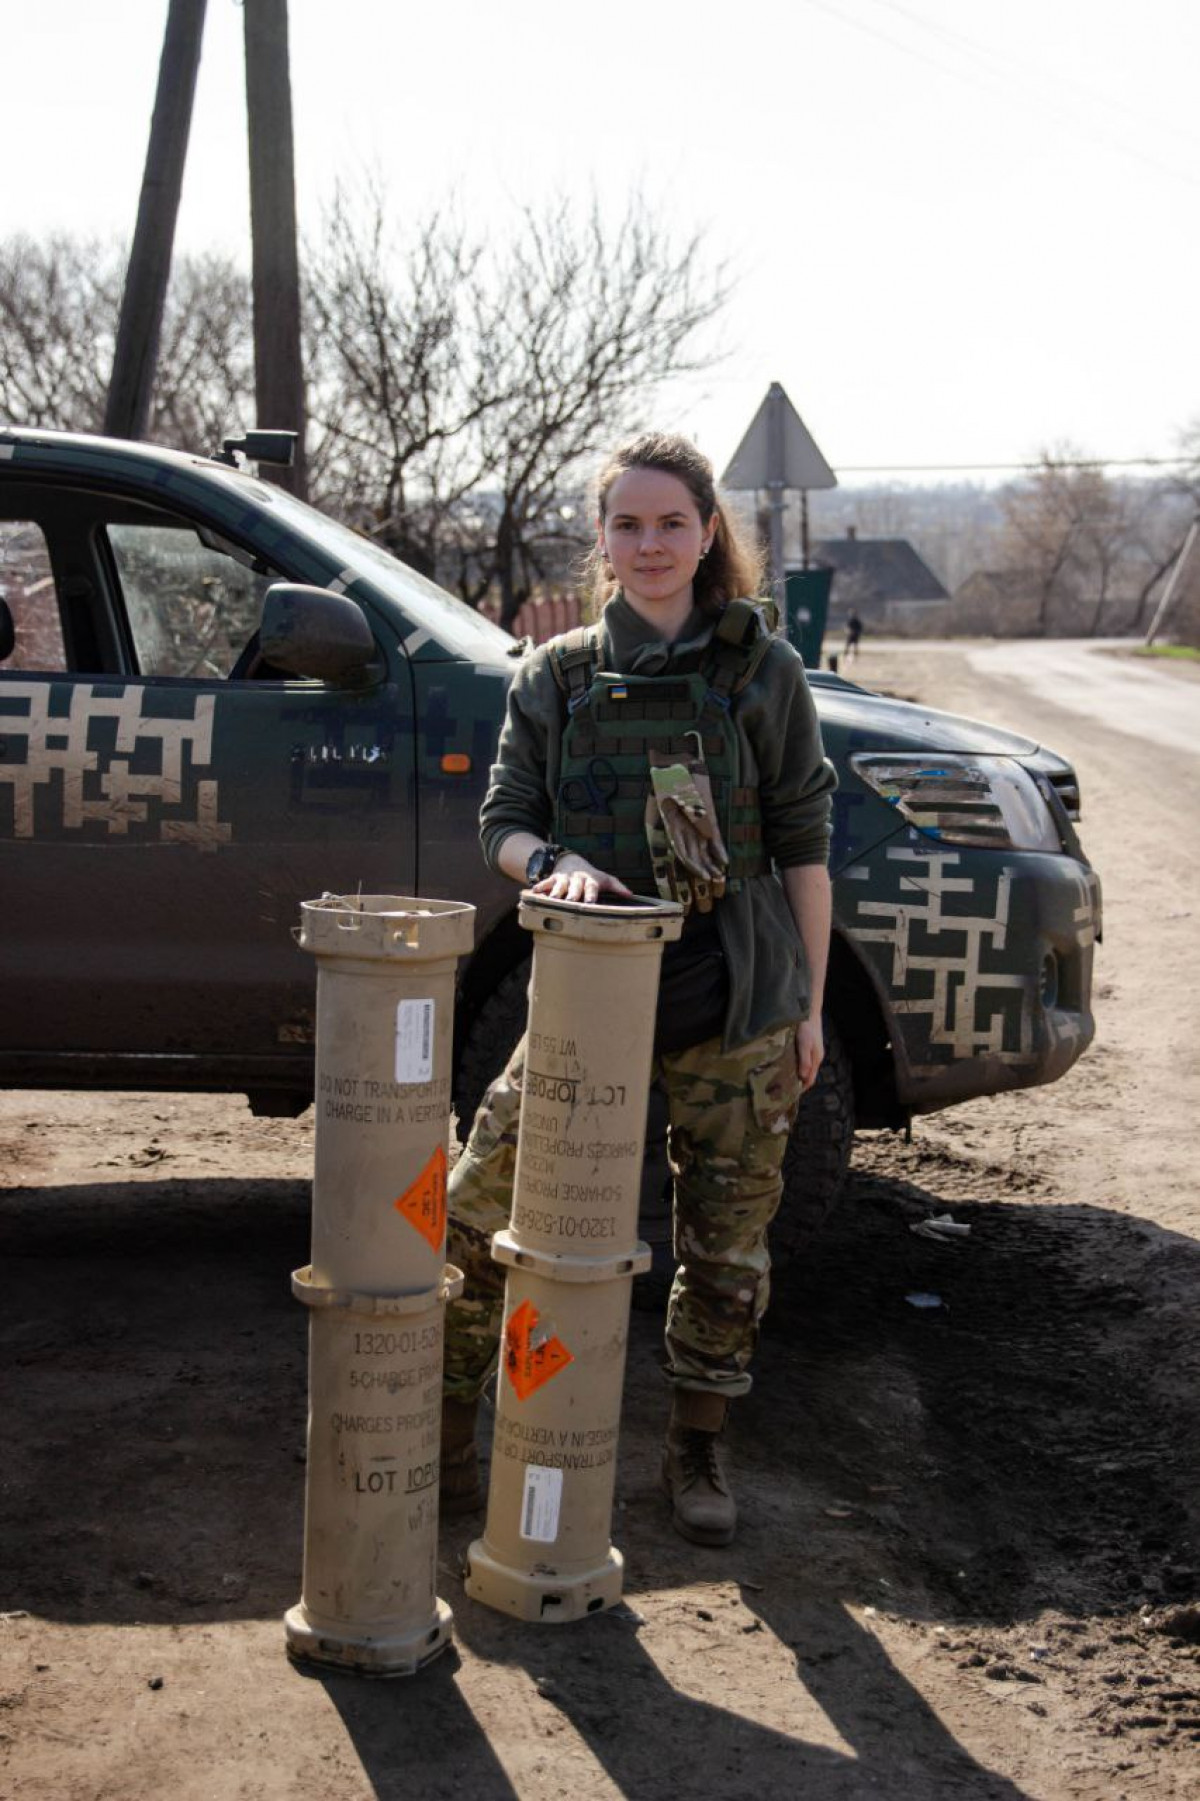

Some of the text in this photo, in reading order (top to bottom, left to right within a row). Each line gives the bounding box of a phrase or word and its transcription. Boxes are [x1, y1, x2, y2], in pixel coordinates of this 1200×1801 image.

[334, 1078, 359, 1097] NOT
[364, 1079, 437, 1099] TRANSPORT
[326, 1100, 373, 1122] CHARGE
[377, 1105, 391, 1123] IN
[395, 1106, 405, 1122] A
[330, 1413, 393, 1434] CHARGES
[559, 1430, 568, 1447] A
[571, 1431, 584, 1448] IN
[520, 1447, 595, 1470] TRANSPORT
[355, 1470, 398, 1494] LOT
